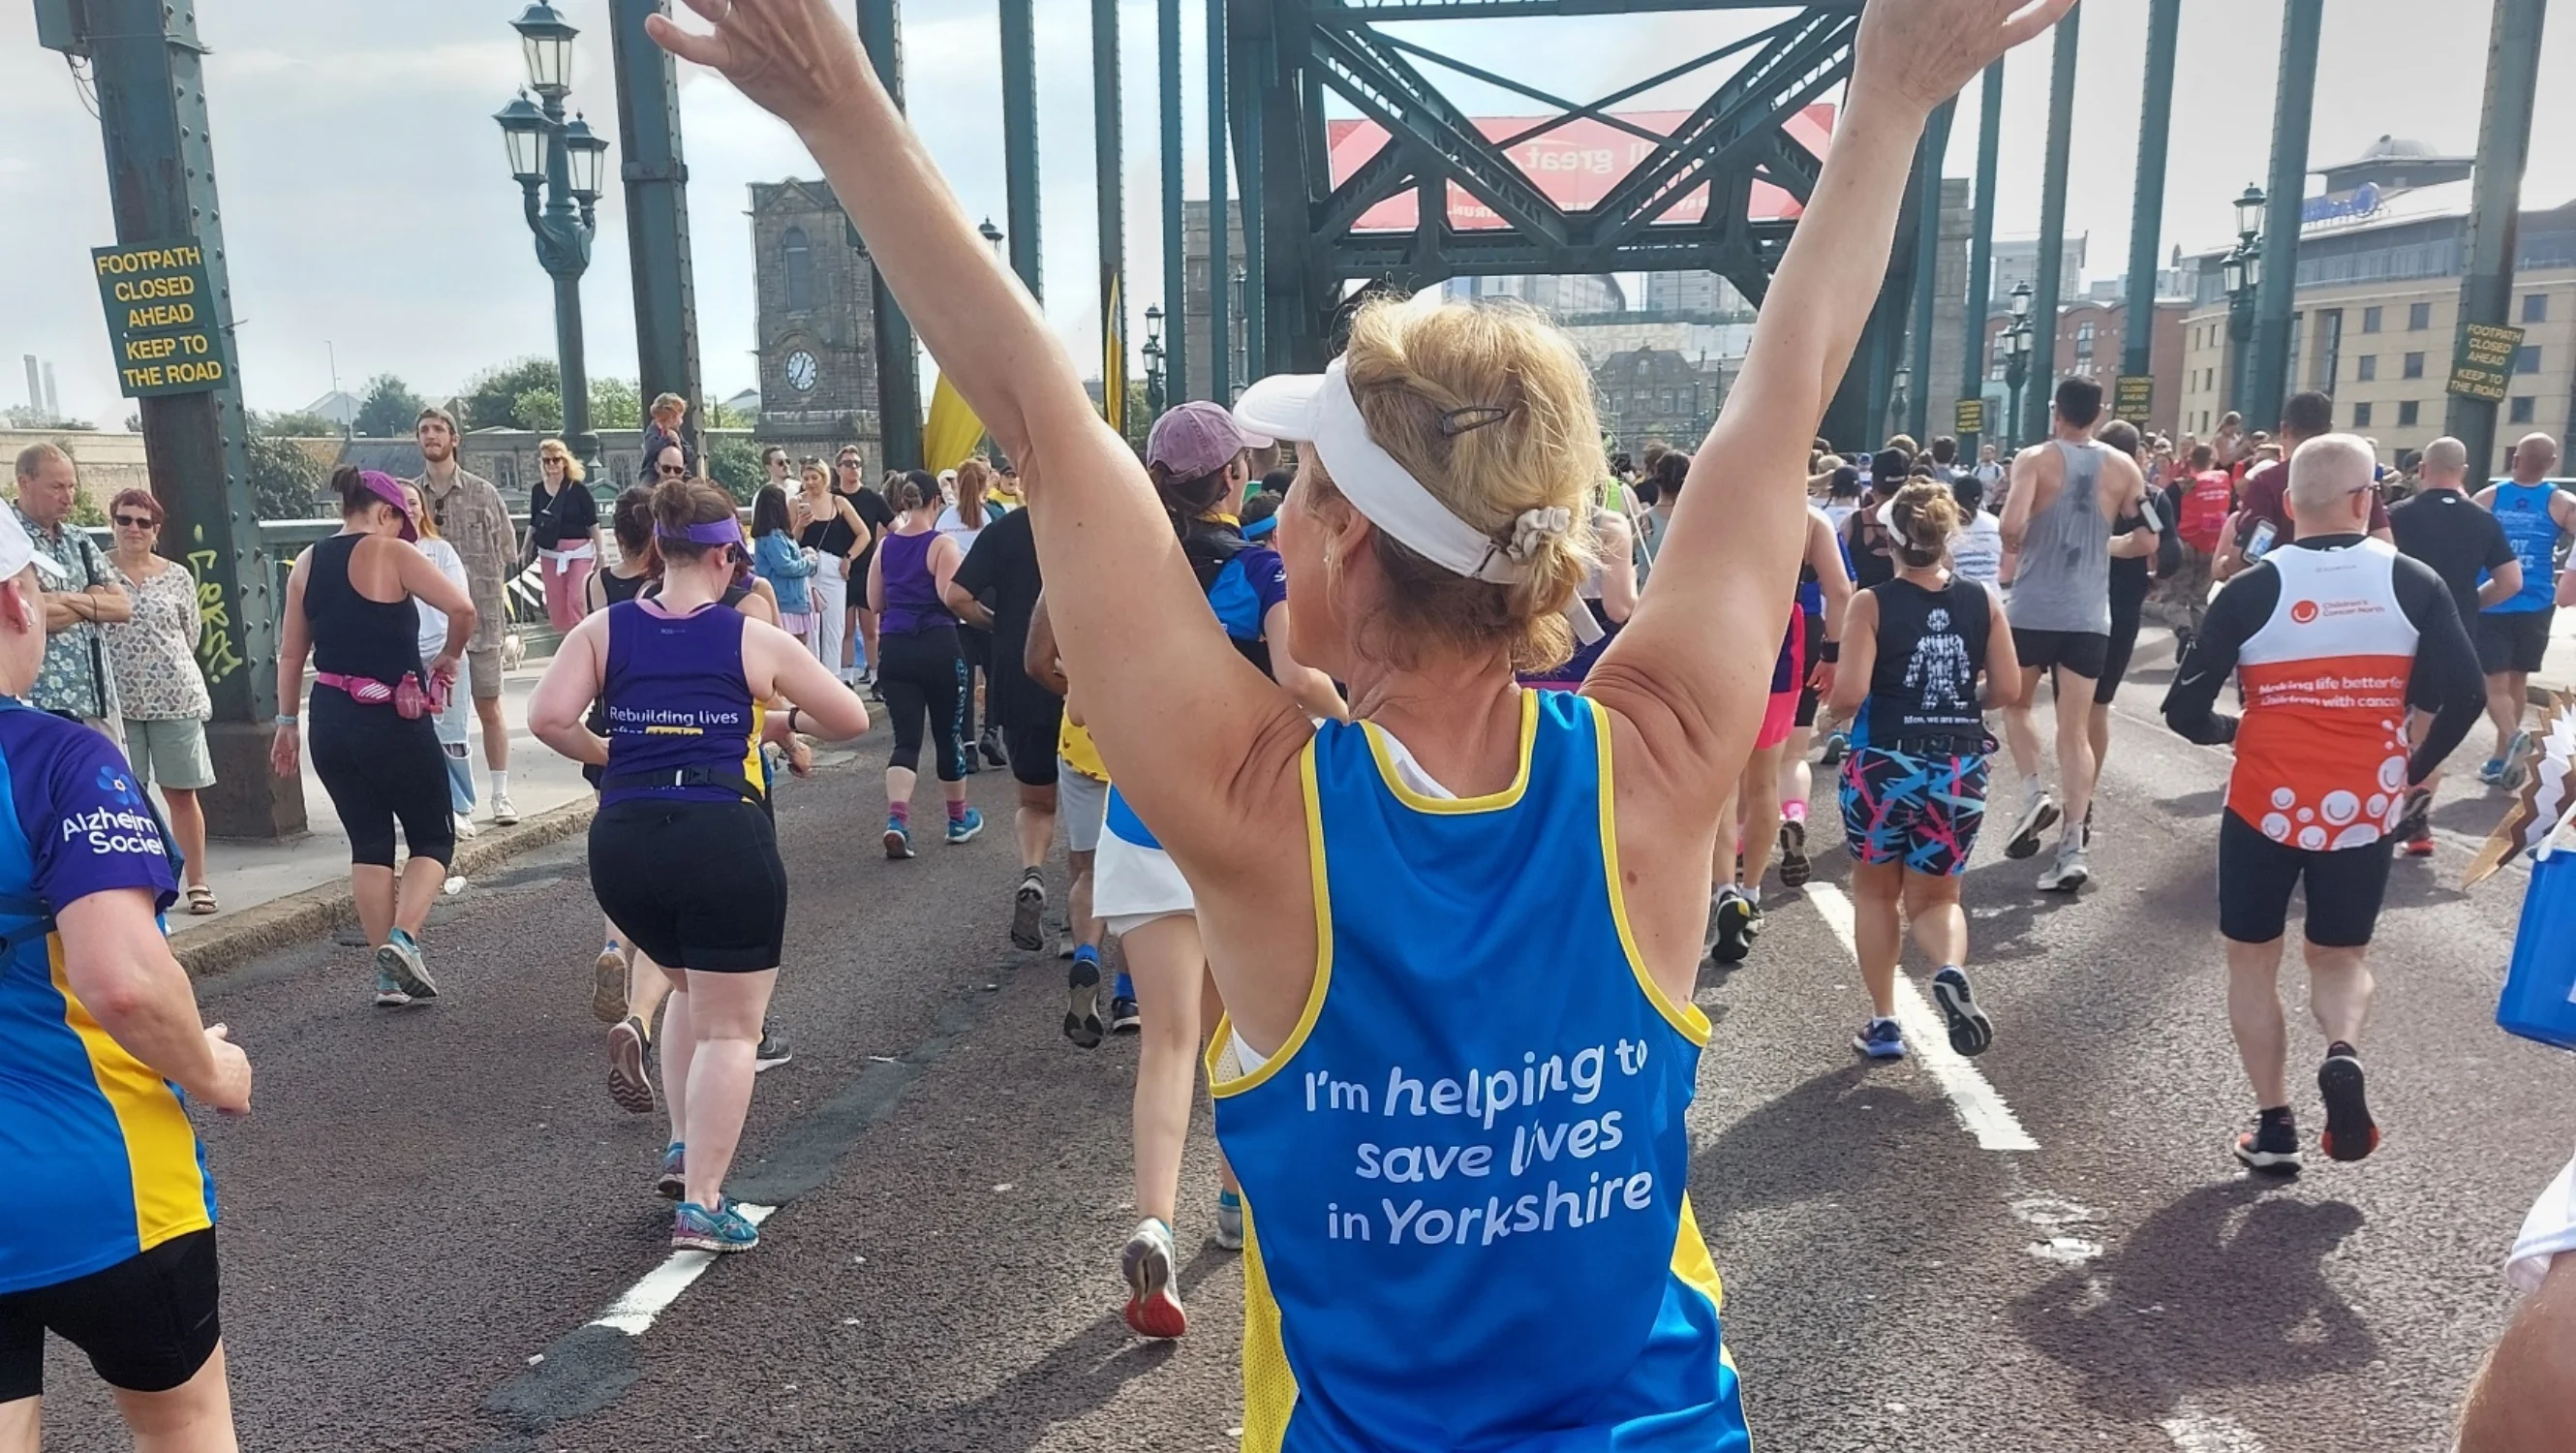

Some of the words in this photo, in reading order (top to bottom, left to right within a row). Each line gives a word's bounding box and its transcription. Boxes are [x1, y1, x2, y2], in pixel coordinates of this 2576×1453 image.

[97, 246, 201, 275] FOOTPATH
[115, 275, 195, 302] CLOSED
[128, 303, 195, 328] AHEAD
[2467, 324, 2522, 342] FOOTPATH
[126, 338, 176, 360] KEEP
[179, 334, 208, 356] TO
[2469, 338, 2512, 354] CLOSED
[2467, 351, 2506, 366] AHEAD
[123, 366, 164, 387] THE
[166, 361, 222, 385] ROAD
[2458, 368, 2487, 381] KEEP
[2489, 373, 2503, 385] TO
[2450, 379, 2472, 392] THE
[2473, 384, 2503, 398] ROAD
[2322, 607, 2356, 617] Cancer
[2358, 605, 2385, 614] North
[2315, 676, 2339, 690] life
[2343, 676, 2387, 690] better
[2322, 695, 2355, 707] with
[610, 706, 694, 727] Rebuilding
[699, 710, 739, 725] lives
[1304, 1069, 1369, 1113] I'm
[1384, 1044, 1606, 1130] helping
[1614, 1038, 1648, 1075] to
[1356, 1143, 1493, 1183] save
[1510, 1110, 1623, 1177] lives
[1328, 1202, 1371, 1241] in
[1382, 1170, 1653, 1246] Yorkshire
